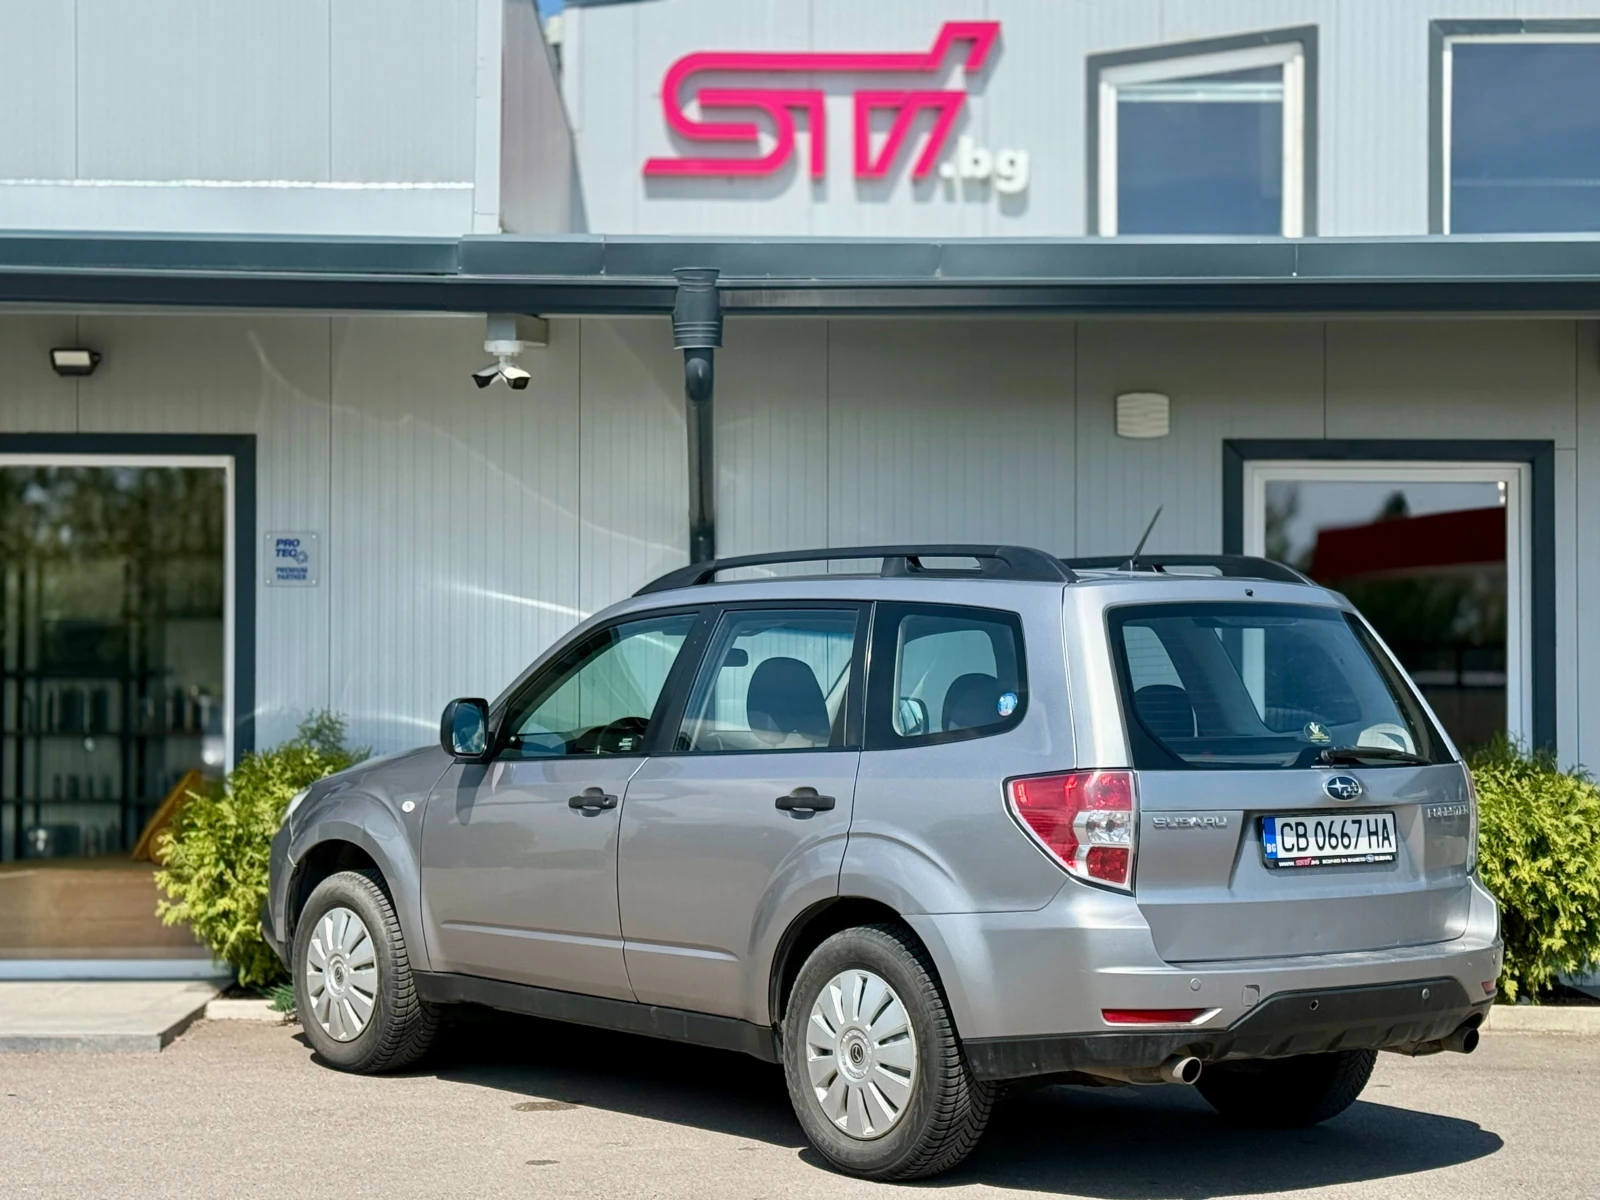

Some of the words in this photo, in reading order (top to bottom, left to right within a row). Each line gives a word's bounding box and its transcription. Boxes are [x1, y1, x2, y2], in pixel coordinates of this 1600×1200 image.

[276, 538, 300, 547] PRO
[1152, 815, 1228, 829] SUBARU
[1314, 819, 1362, 852] 0667
[1366, 818, 1392, 849] HA
[1266, 843, 1277, 853] BG
